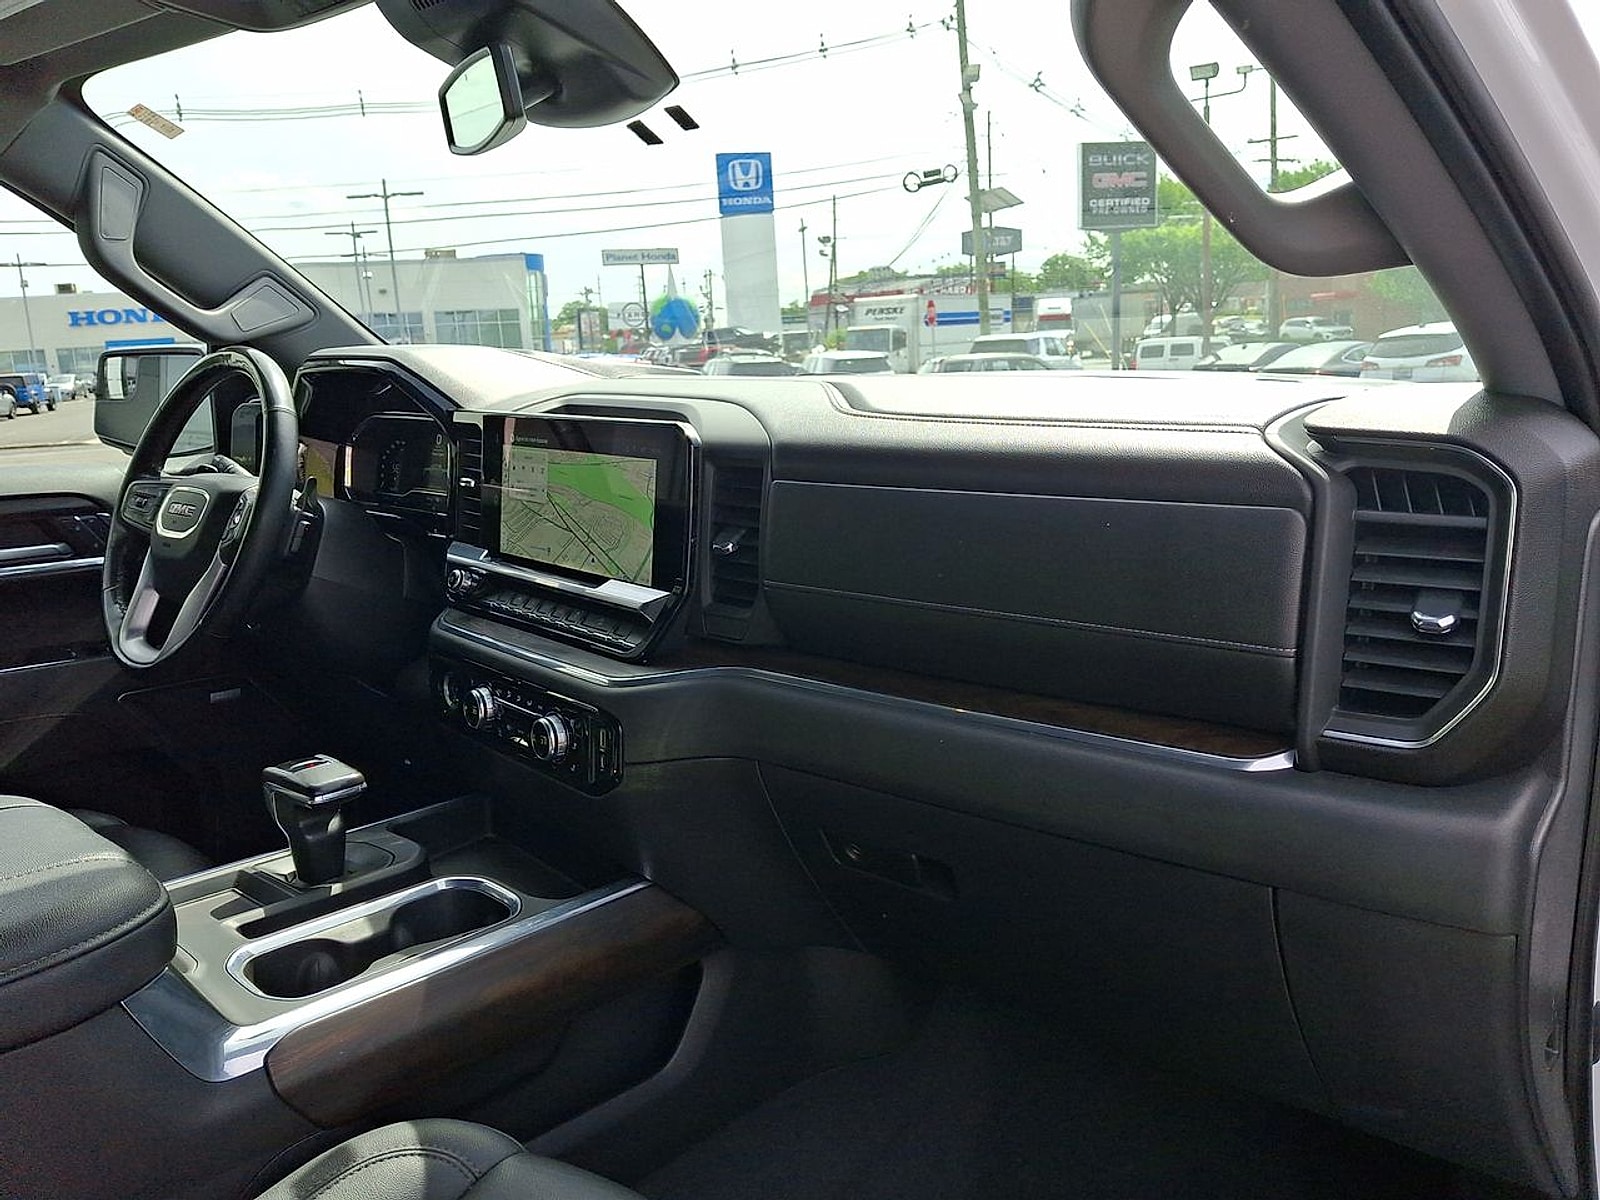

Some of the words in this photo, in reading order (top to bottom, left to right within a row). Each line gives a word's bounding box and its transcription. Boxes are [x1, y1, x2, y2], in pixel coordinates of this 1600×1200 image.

[1089, 153, 1149, 166] BUICK
[1092, 171, 1148, 188] GMC
[721, 197, 772, 205] HONDA
[1089, 197, 1150, 207] CERTIFIED
[641, 251, 676, 260] Honda
[865, 307, 905, 316] PENSKE
[68, 308, 164, 327] HON
[169, 502, 197, 517] GMC
